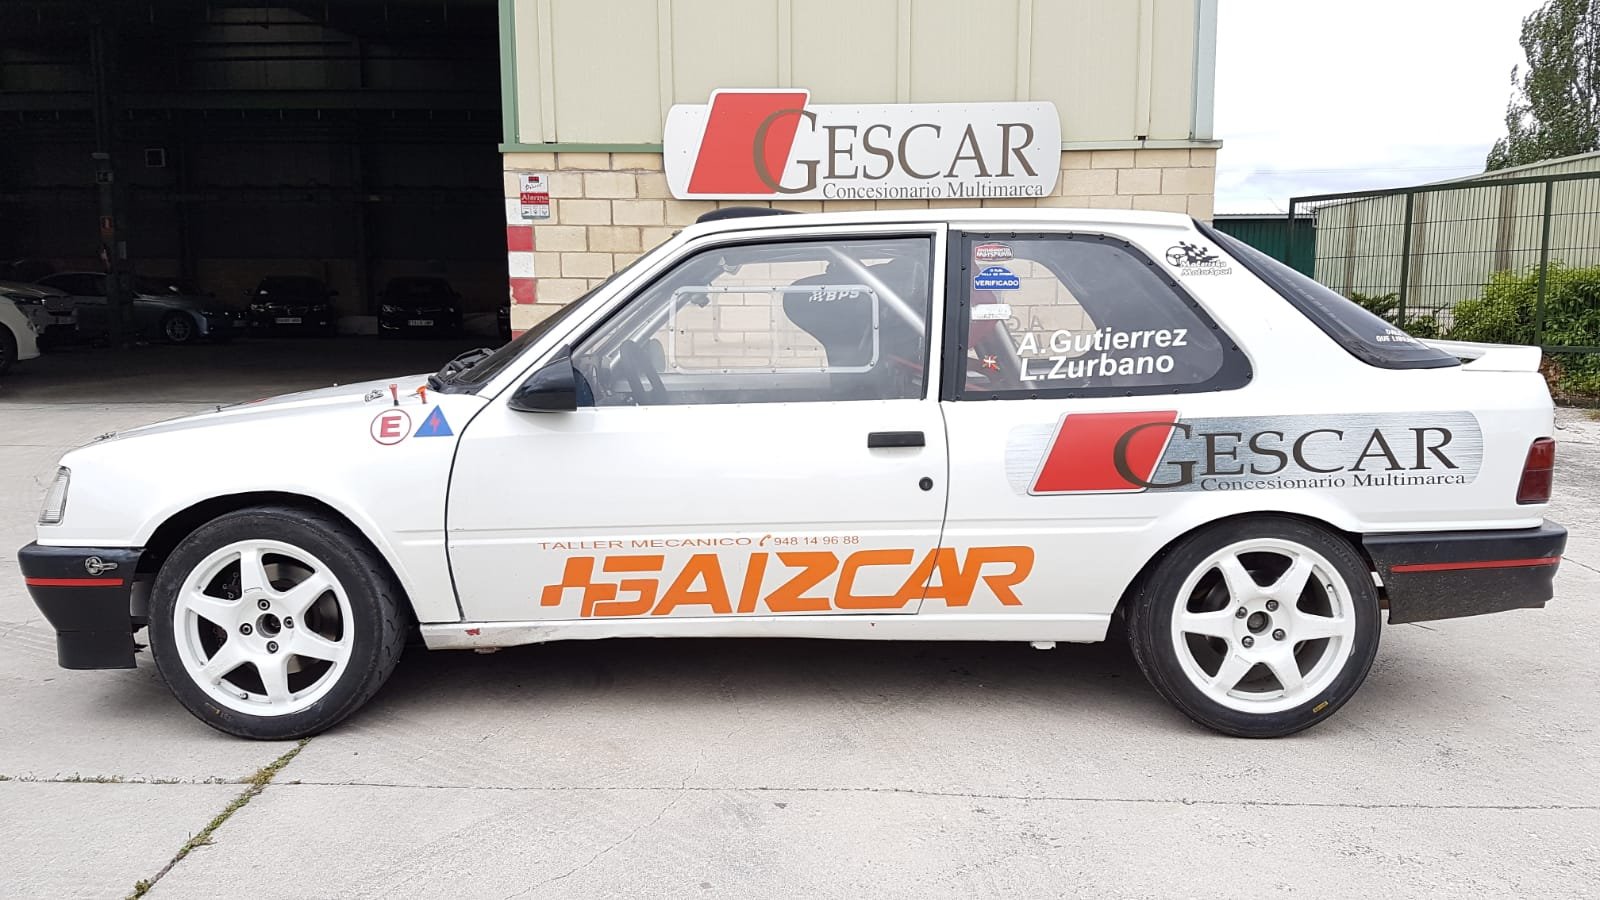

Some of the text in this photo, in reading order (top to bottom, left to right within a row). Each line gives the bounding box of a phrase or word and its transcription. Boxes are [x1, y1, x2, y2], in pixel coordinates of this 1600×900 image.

[753, 108, 1038, 193] GESCAR
[822, 181, 1044, 199] Concesionario Multimarca
[1016, 327, 1188, 356] A.Gutierrez
[1019, 354, 1175, 382] L.Zurbano
[380, 415, 402, 438] E
[1113, 422, 1460, 489] GESCAR
[1201, 473, 1466, 492] Concesionario Multimarca
[537, 535, 860, 550] TALLER MECANICO 948 14 96 88
